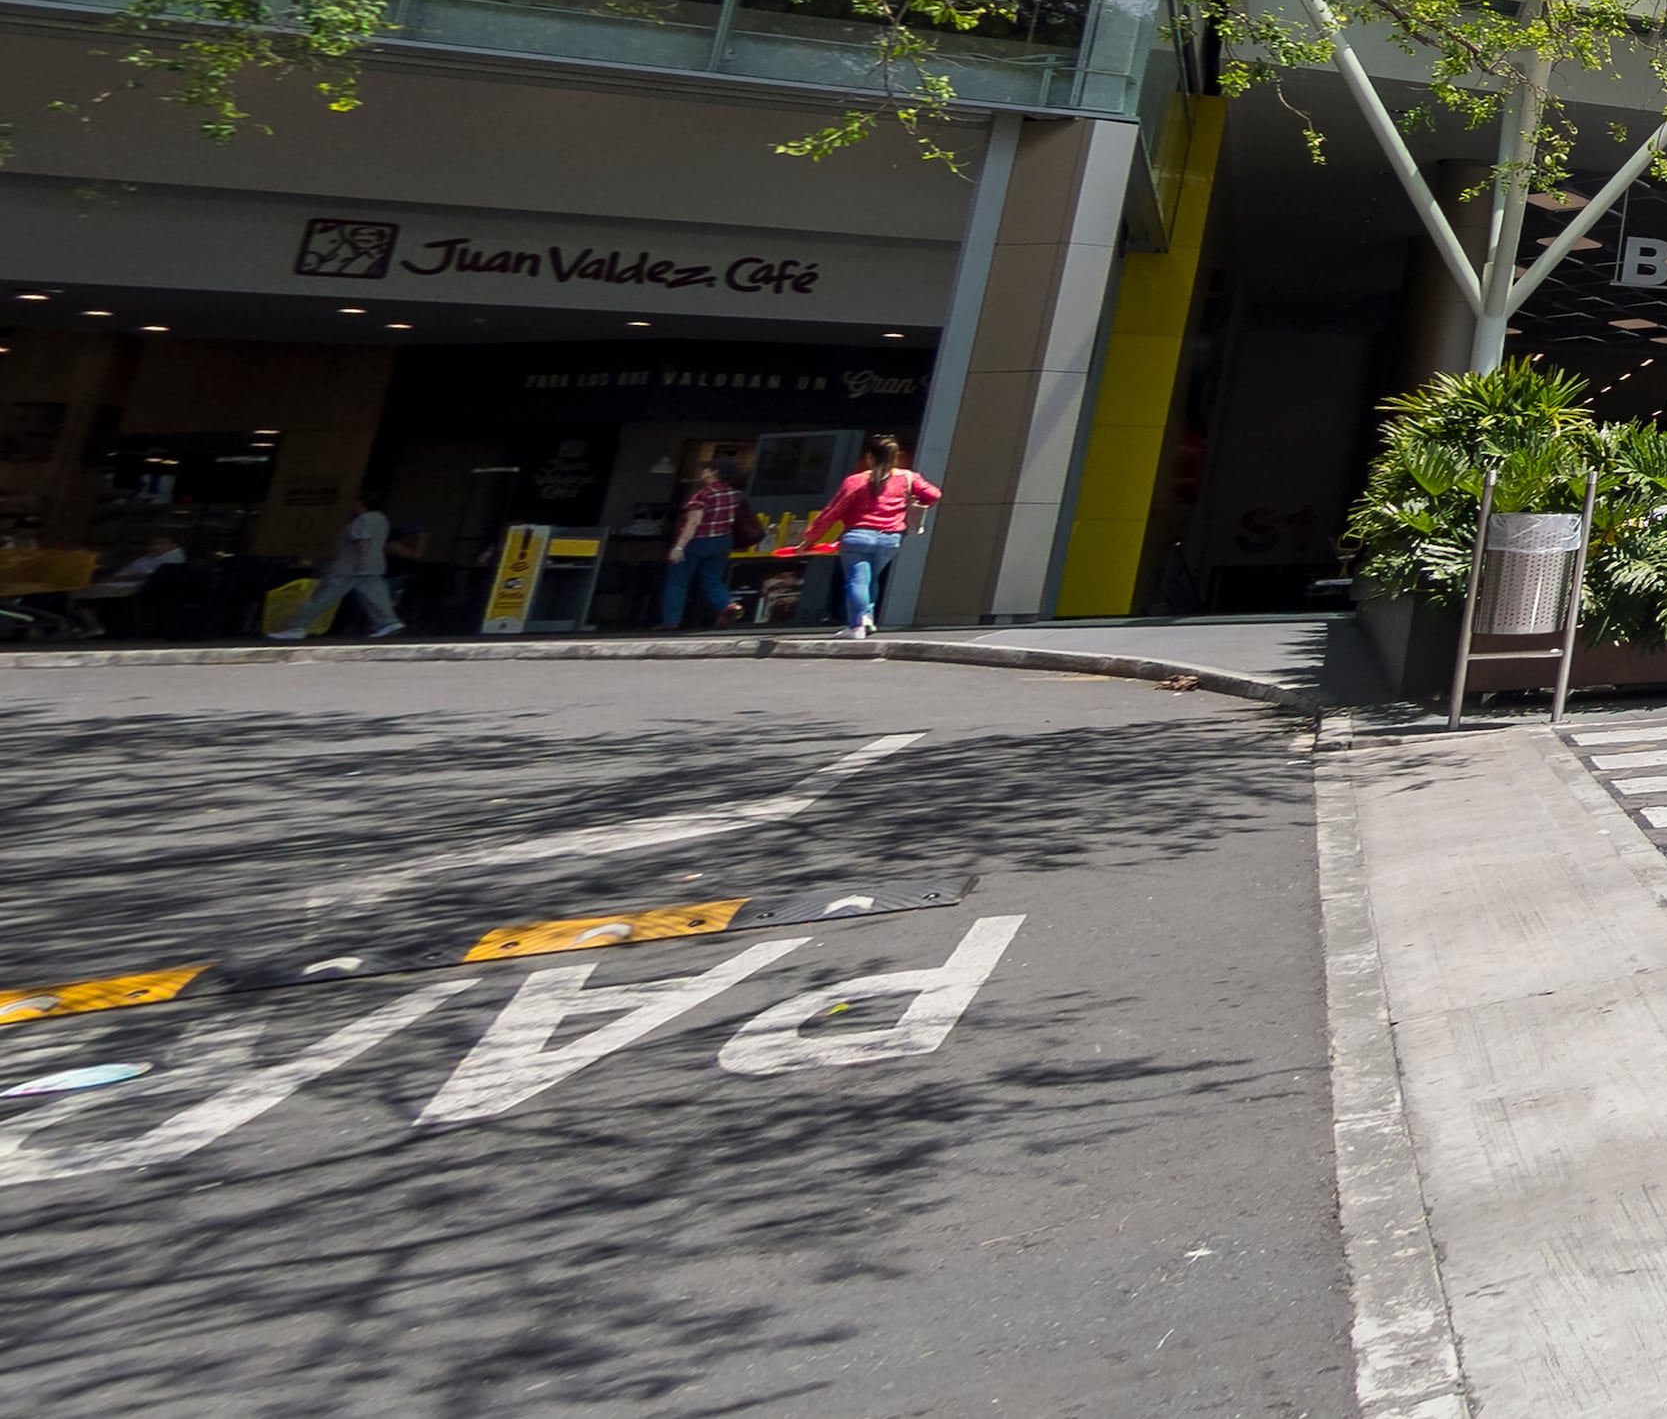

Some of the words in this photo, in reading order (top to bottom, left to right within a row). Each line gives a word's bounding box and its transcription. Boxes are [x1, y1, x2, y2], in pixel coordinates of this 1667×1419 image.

[401, 237, 541, 276] Juan
[724, 256, 819, 295] Café
[662, 370, 782, 390] VALORAN
[796, 375, 828, 391] UN
[841, 368, 918, 399] Gran
